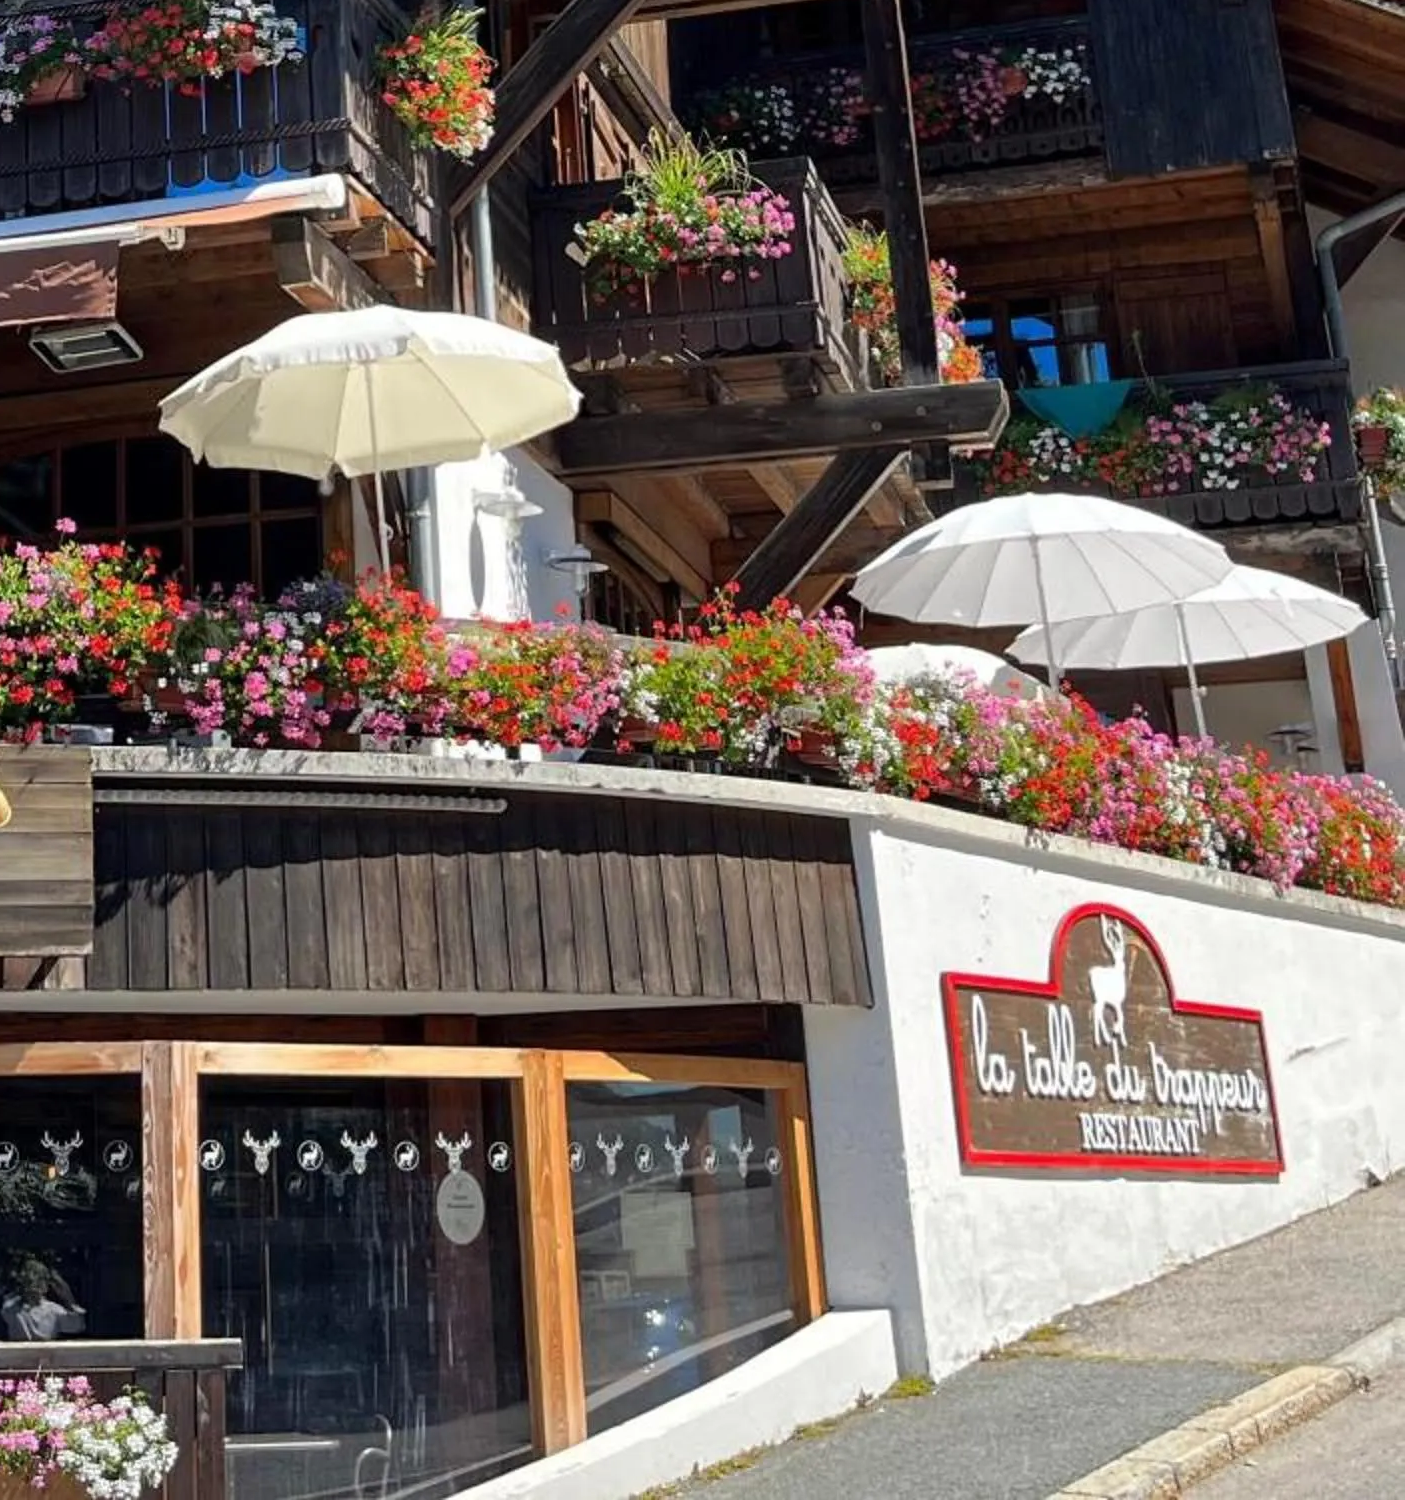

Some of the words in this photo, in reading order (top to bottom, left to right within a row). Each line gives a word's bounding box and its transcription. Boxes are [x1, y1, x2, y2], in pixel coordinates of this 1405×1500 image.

[971, 994, 1016, 1094] la
[1019, 1003, 1096, 1099] table
[1105, 1037, 1146, 1102] du
[1149, 1042, 1267, 1137] trappeur
[1080, 1113, 1201, 1155] RESTAURANT
